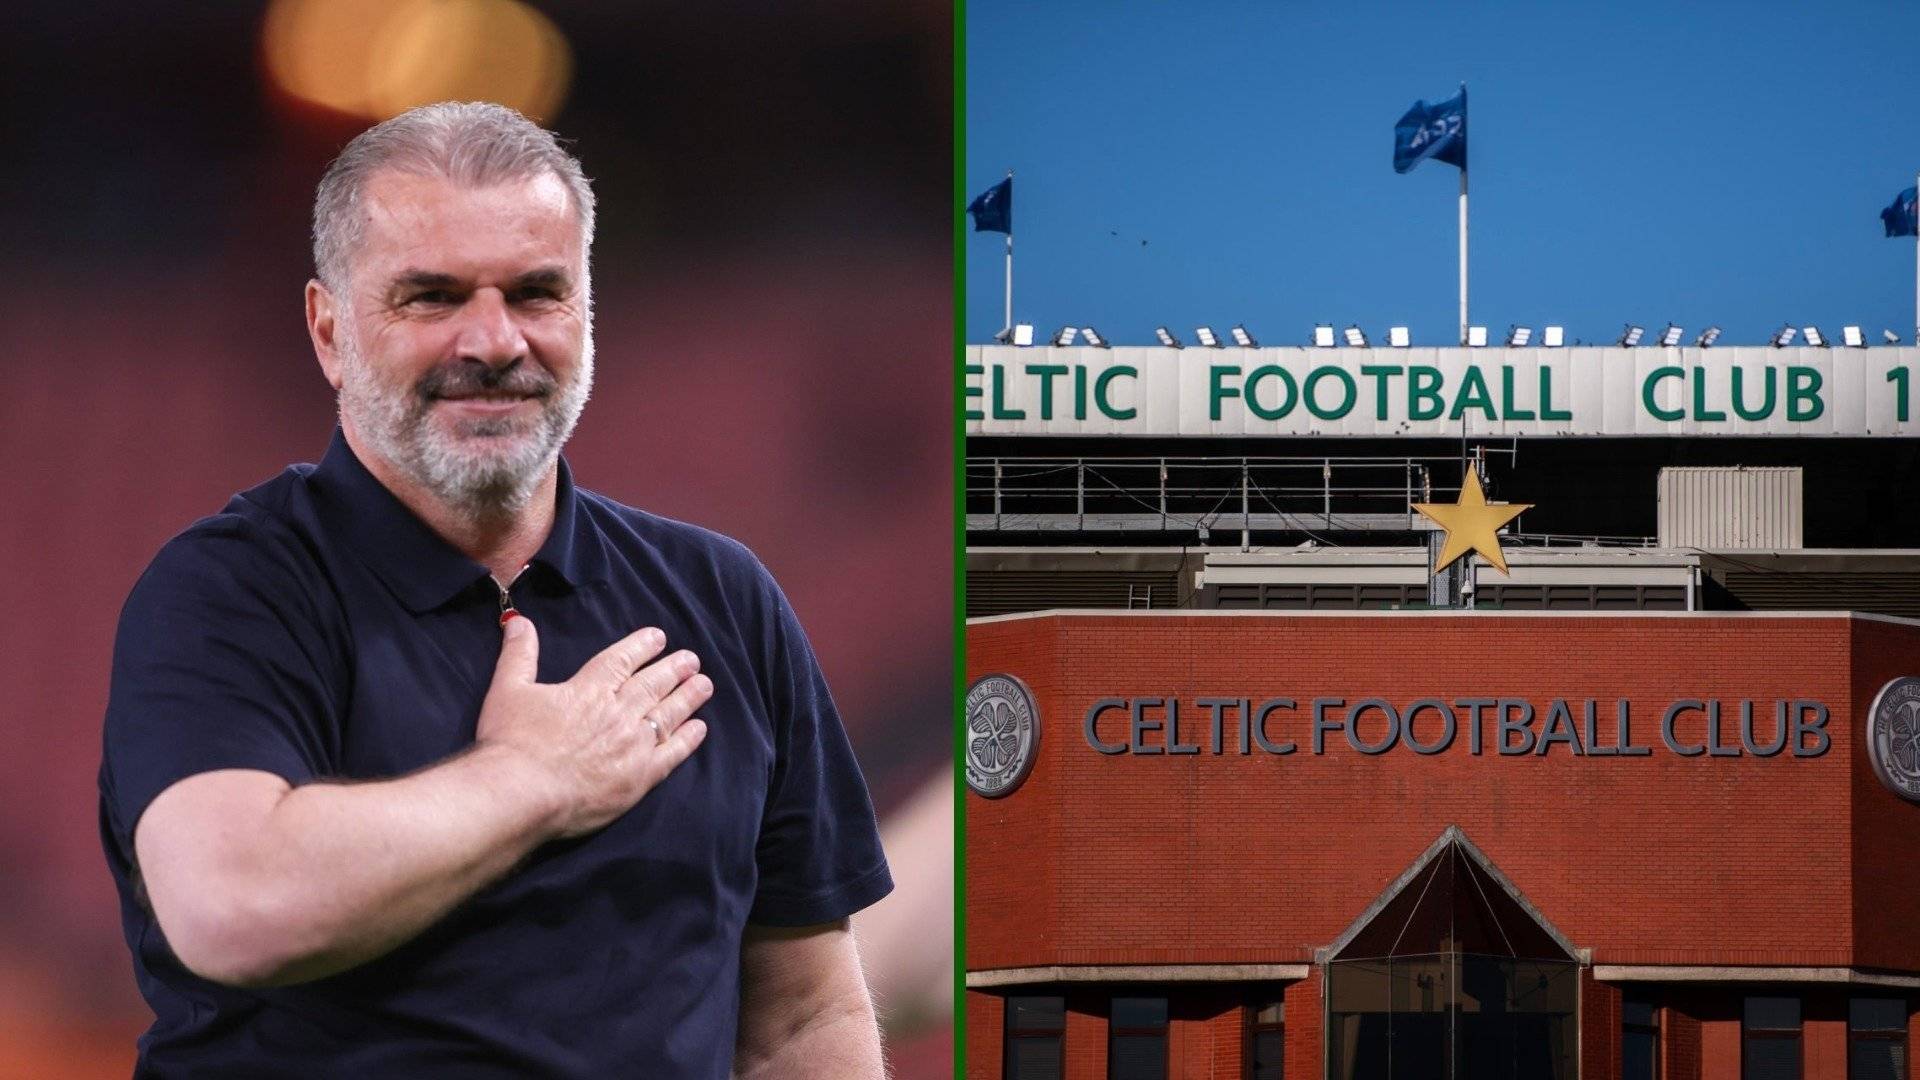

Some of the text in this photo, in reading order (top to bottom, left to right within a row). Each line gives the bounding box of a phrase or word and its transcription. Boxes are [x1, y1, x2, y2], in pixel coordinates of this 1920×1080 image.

[1210, 365, 1573, 421] FOOTBALL
[1642, 366, 1824, 422] CLUB
[1886, 366, 1909, 422] 1
[1084, 696, 1831, 757] CELTIC FOOTBALL CLUB
